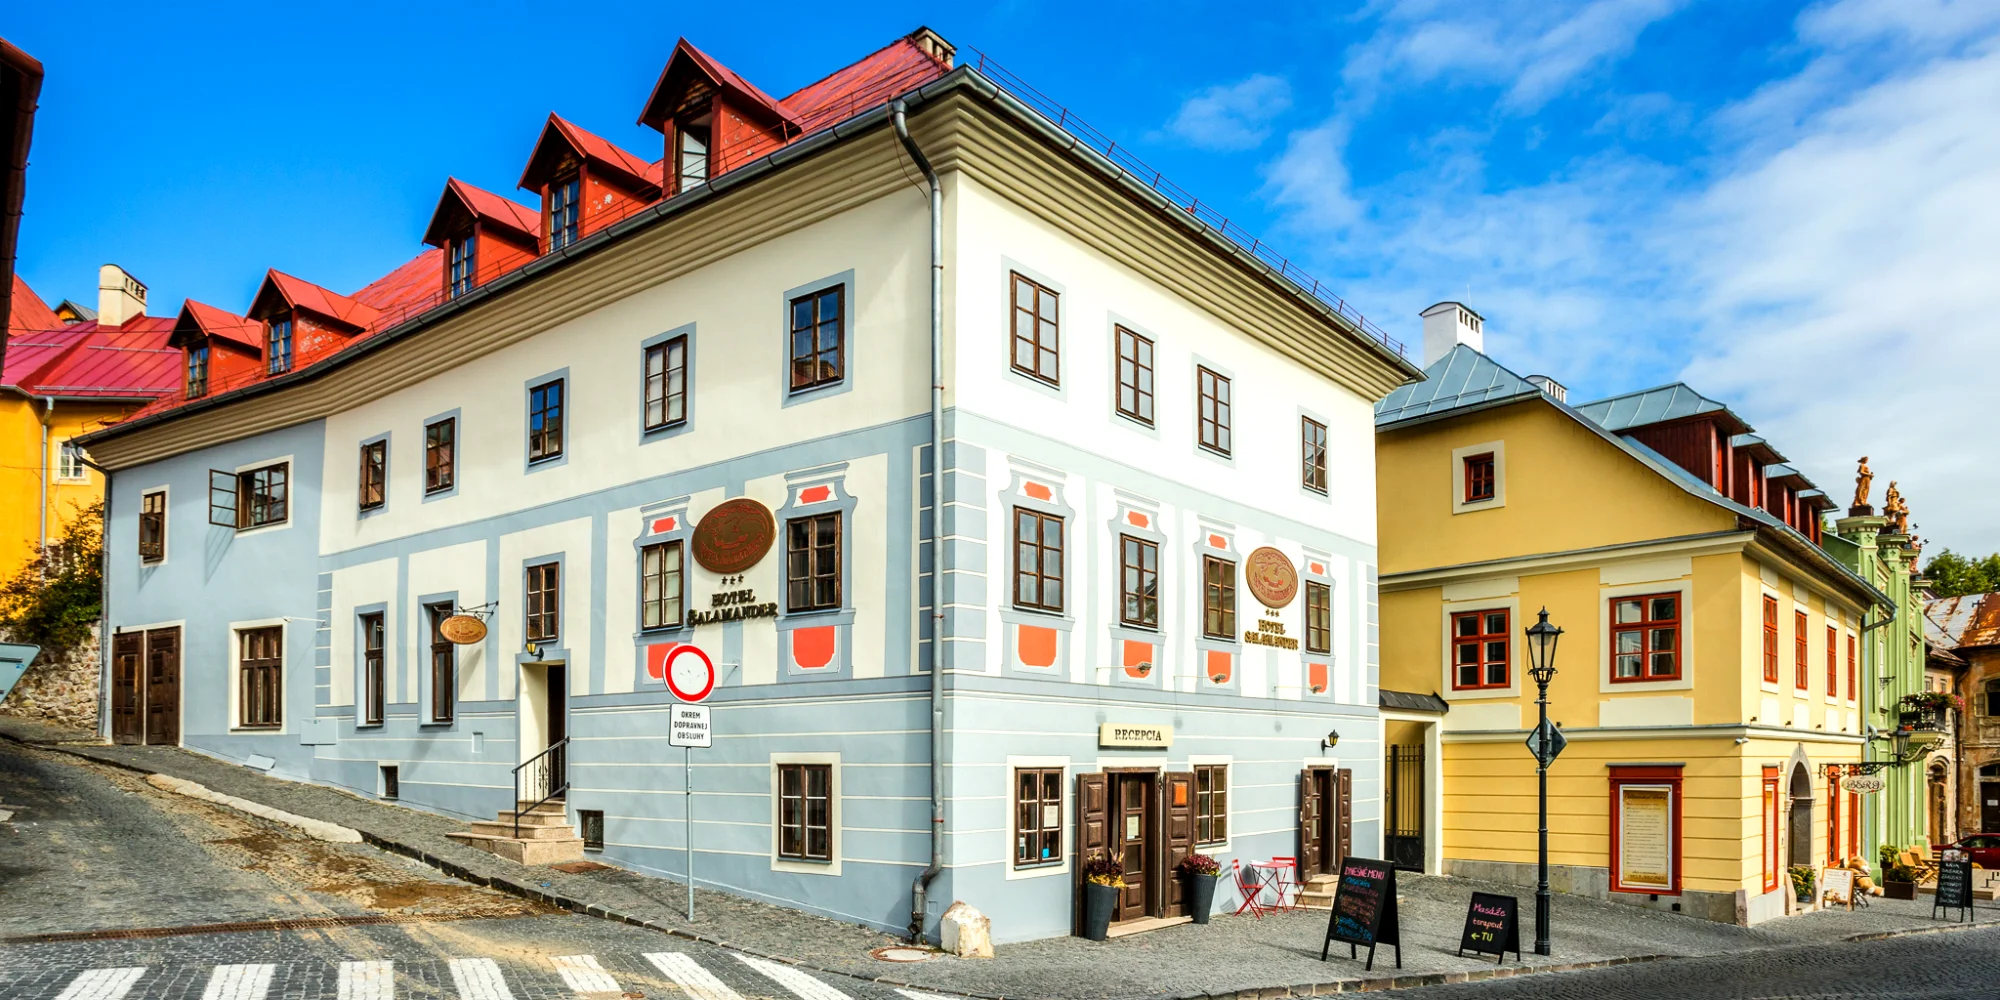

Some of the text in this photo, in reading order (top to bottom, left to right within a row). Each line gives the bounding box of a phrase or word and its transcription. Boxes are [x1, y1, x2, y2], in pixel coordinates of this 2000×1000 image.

[711, 589, 756, 607] HOTEL
[687, 602, 778, 627] SALAMANDER
[1258, 619, 1286, 635] HOTEL
[1244, 630, 1299, 650] SALAMANDER
[681, 711, 700, 719] OKREM
[674, 721, 708, 730] DOPRAVNEJ
[677, 732, 704, 740] OBSLUHY
[1115, 728, 1162, 741] RECEPCIA
[1368, 869, 1385, 880] MENU
[1473, 902, 1506, 917] Masáže
[1481, 931, 1493, 942] TU
